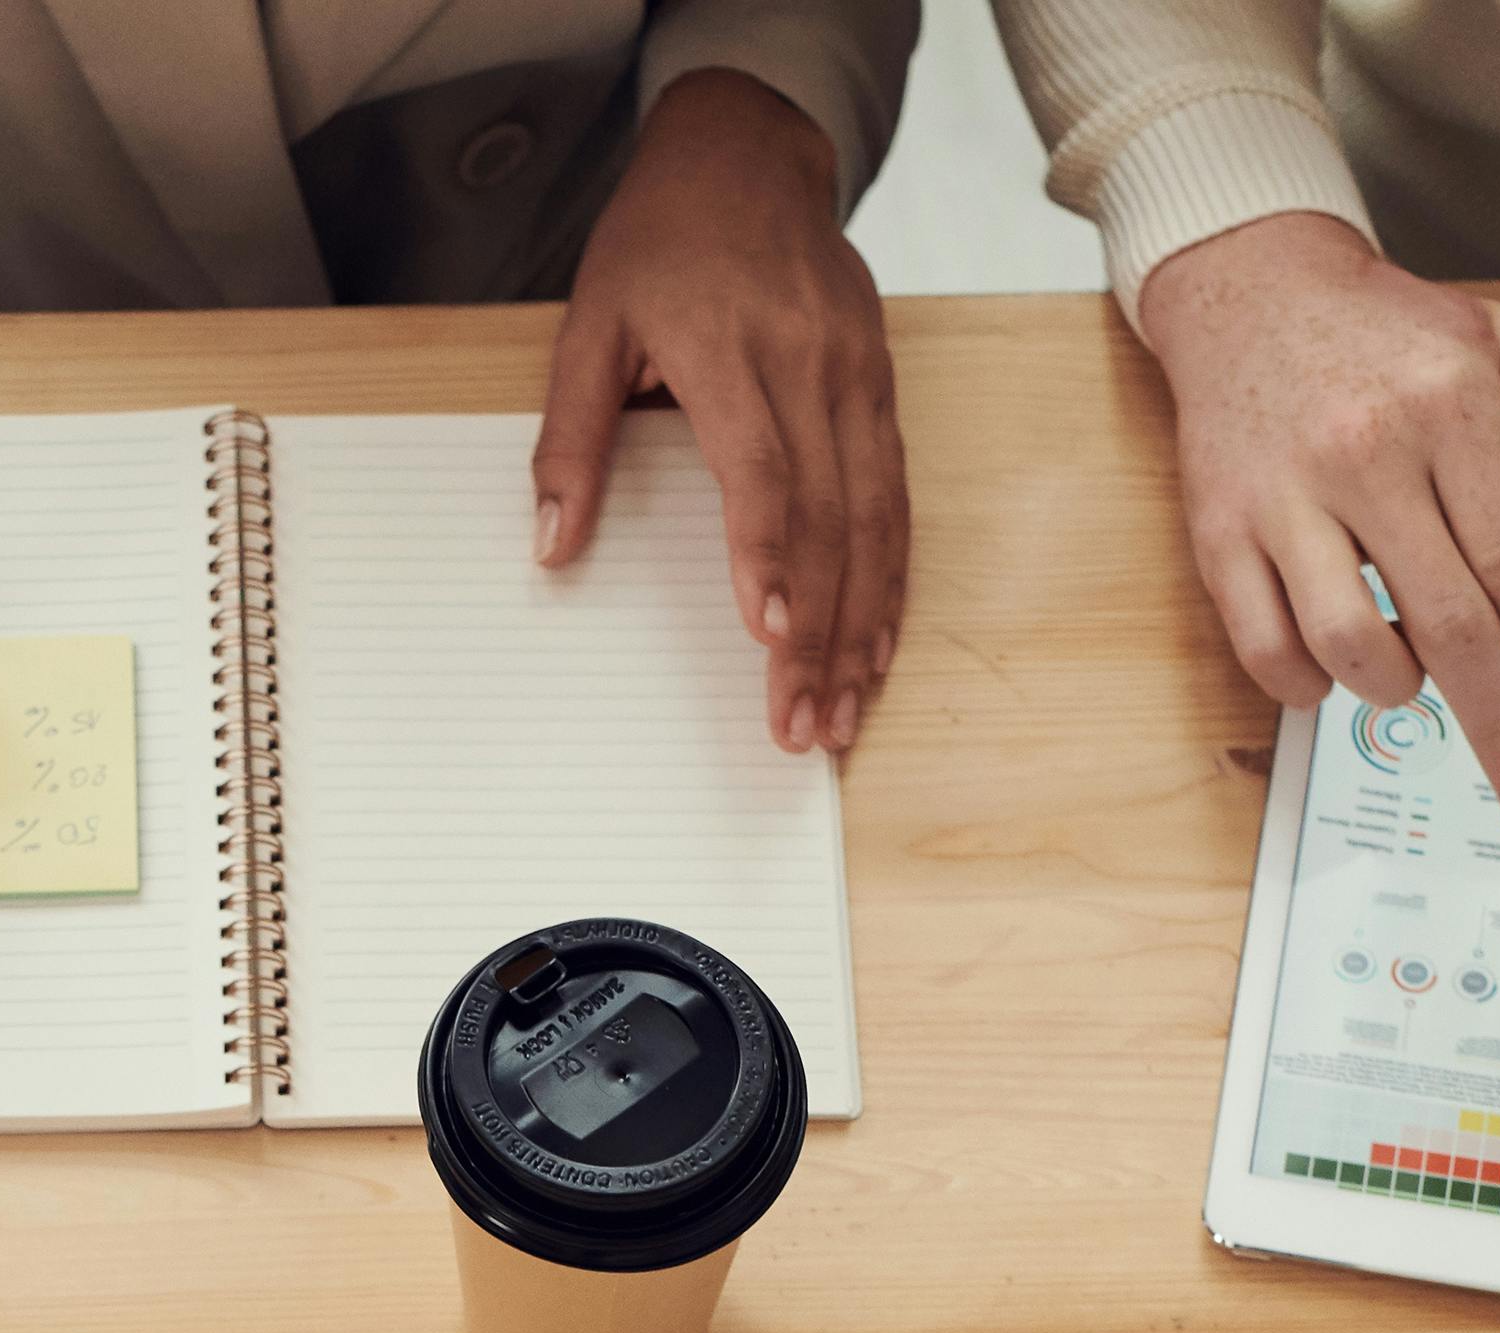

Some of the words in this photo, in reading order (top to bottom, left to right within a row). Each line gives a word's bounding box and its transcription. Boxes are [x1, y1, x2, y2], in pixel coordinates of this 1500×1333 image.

[455, 998, 489, 1048] PUSH
[514, 1025, 563, 1060] LOCK
[506, 1138, 613, 1192] CONTENTS
